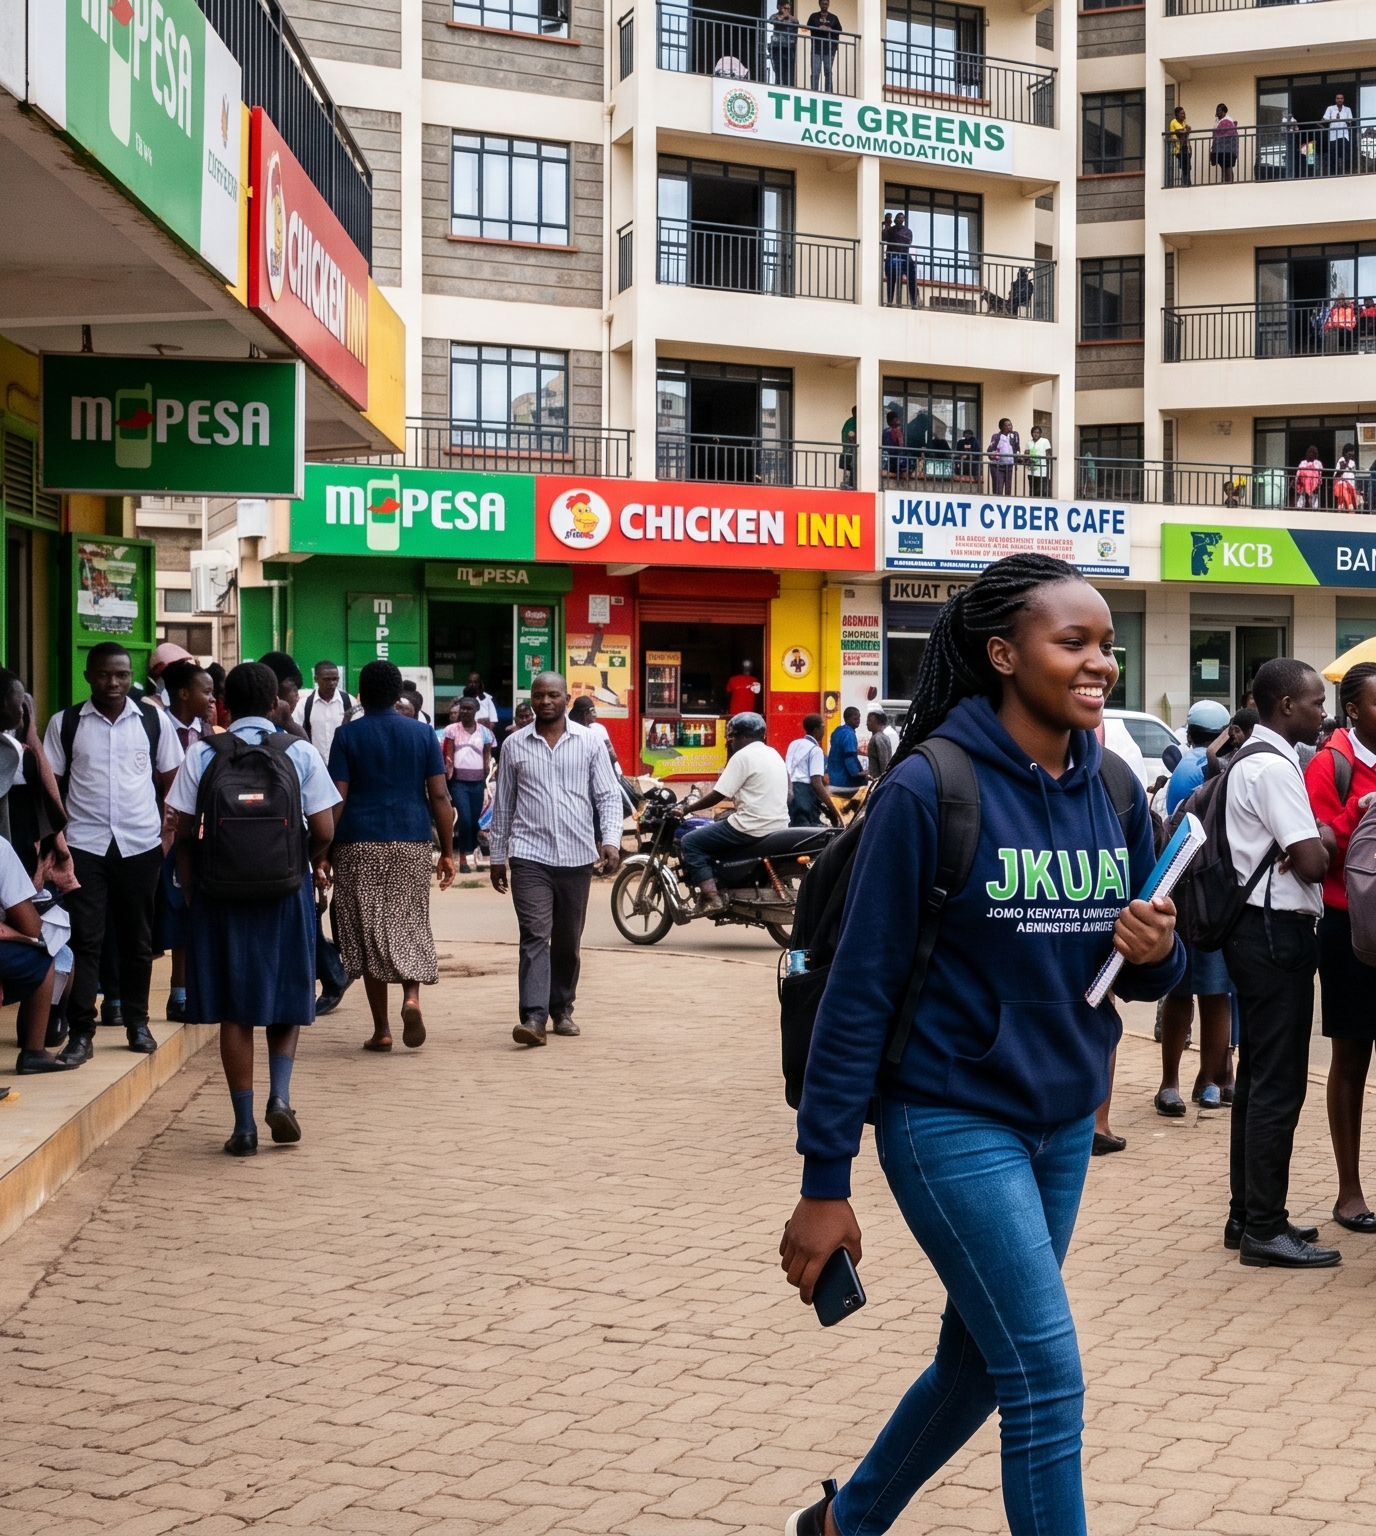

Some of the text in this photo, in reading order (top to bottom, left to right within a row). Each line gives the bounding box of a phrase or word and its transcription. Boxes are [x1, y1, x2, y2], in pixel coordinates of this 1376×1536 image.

[767, 91, 1005, 151] THE GREENS
[801, 128, 973, 165] ACCOMMODATION
[288, 210, 366, 367] CHICKEN INN
[620, 503, 860, 548] CHICKEN INN
[892, 499, 1125, 534] JKUAT CYBER CAFE
[1223, 542, 1273, 568] KCB
[893, 583, 940, 599] JKUAT
[986, 847, 1130, 901] JKUAT
[986, 908, 1023, 918] JOMO
[1027, 908, 1080, 919] KENYATTA
